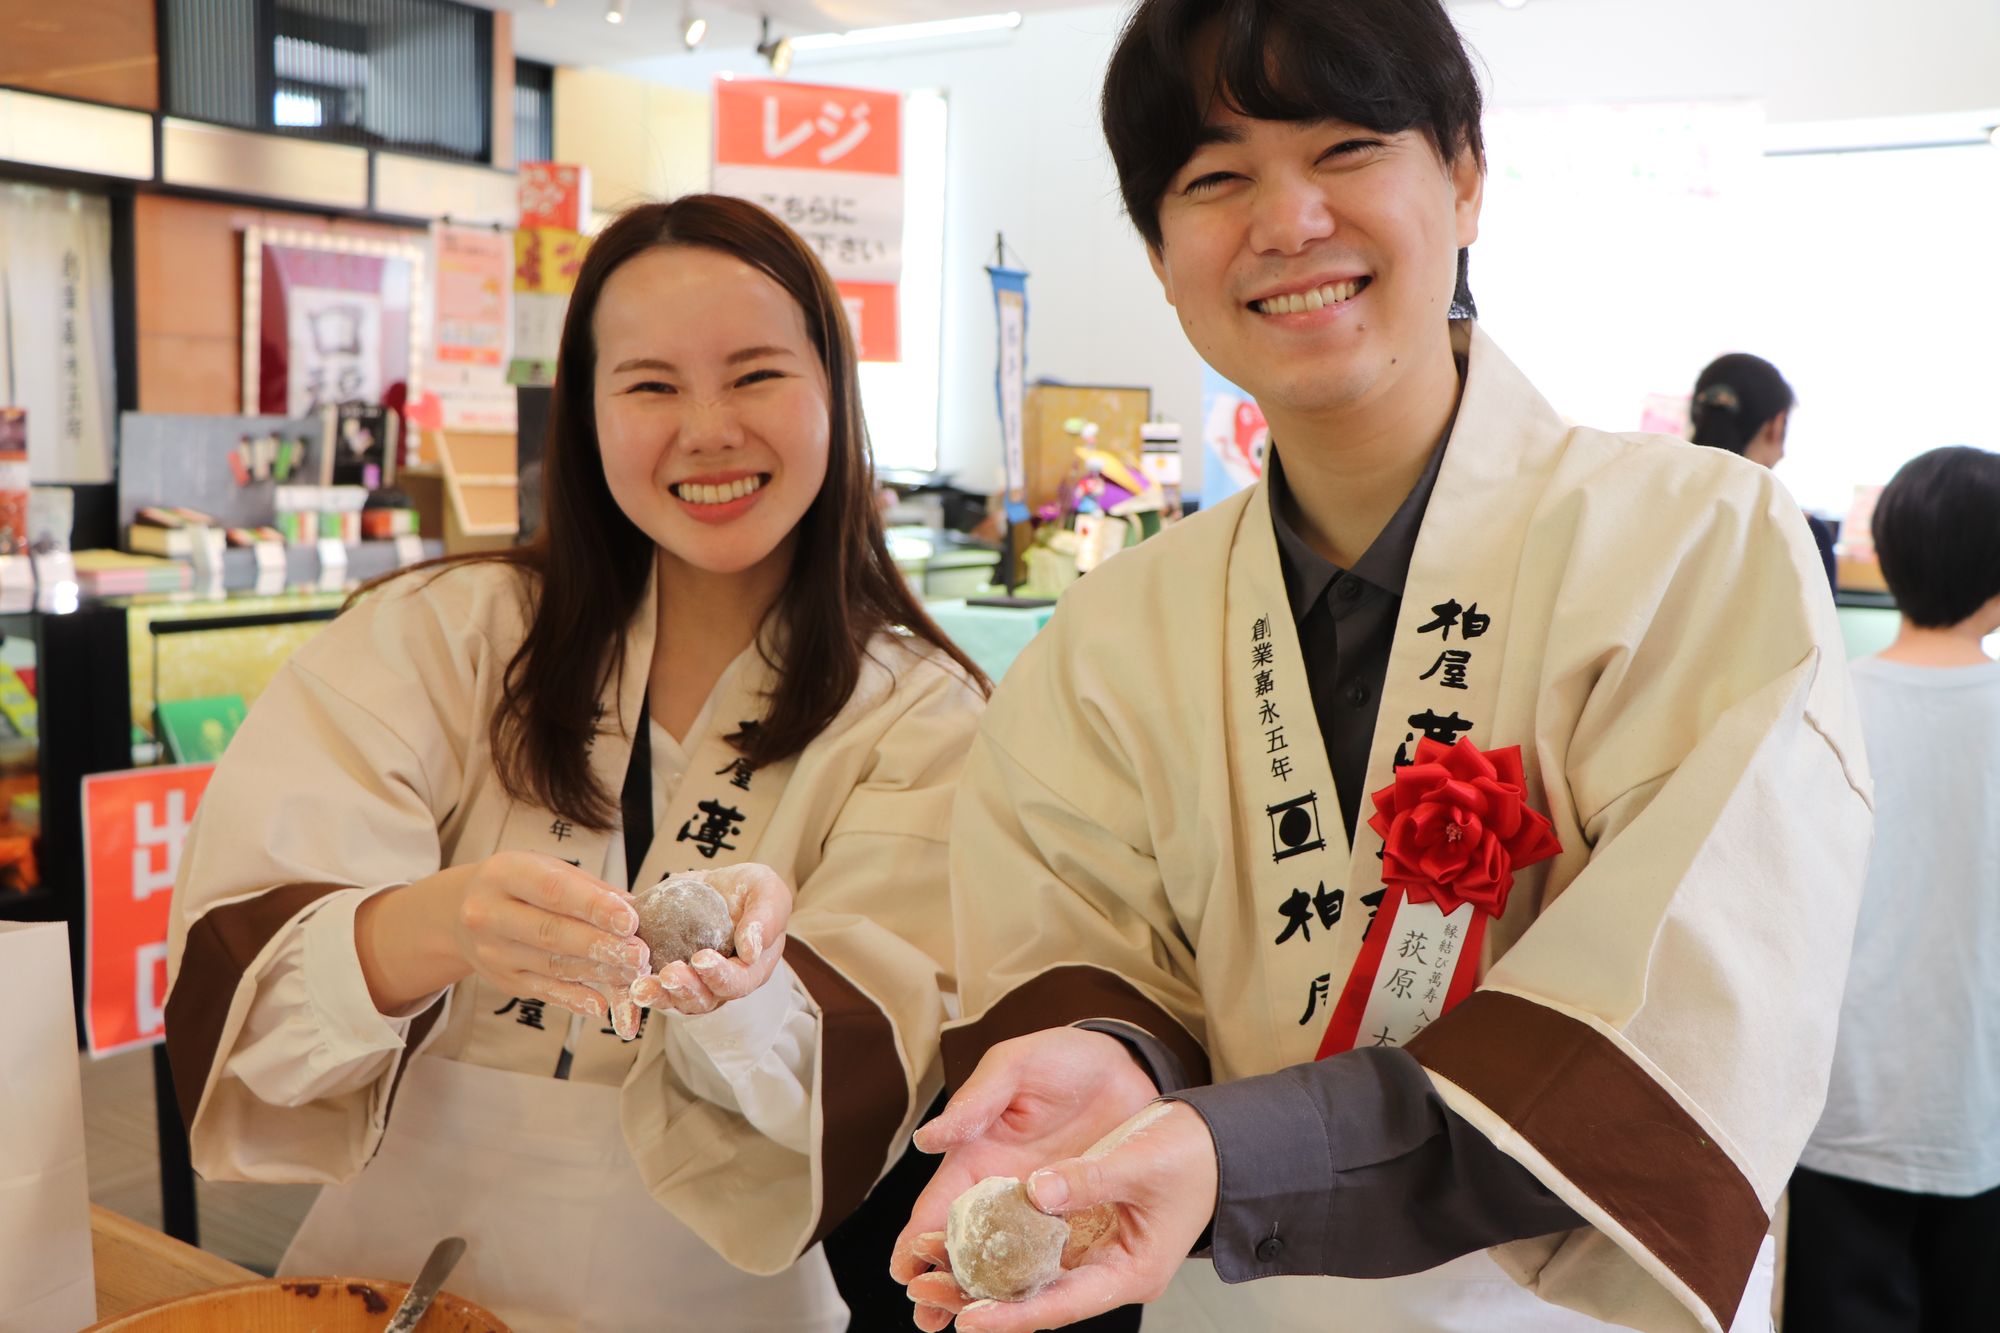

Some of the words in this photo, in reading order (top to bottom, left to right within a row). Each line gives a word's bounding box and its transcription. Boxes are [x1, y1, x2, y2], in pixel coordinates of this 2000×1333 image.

[763, 96, 871, 164] レジ
[1252, 613, 1293, 782] 創業嘉永五年
